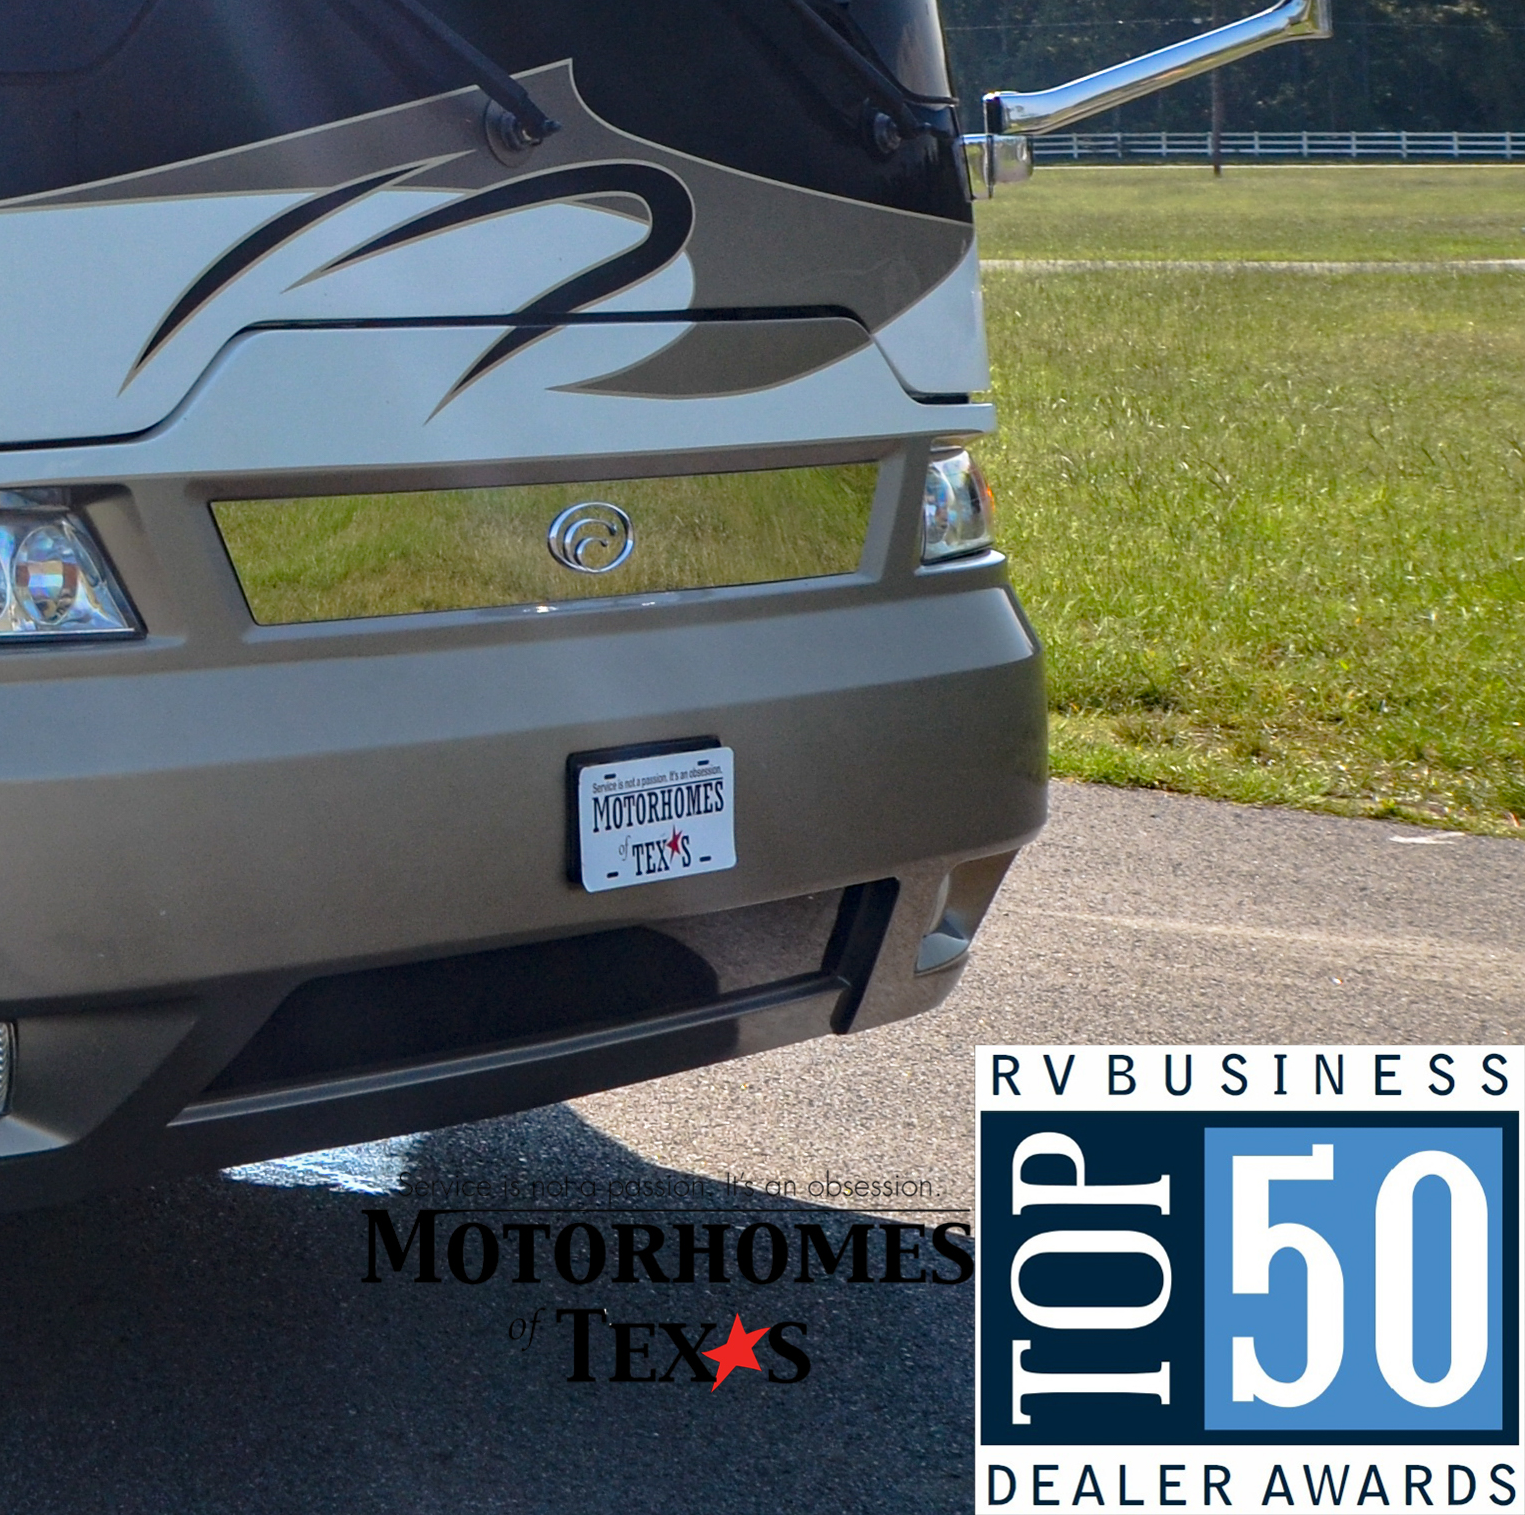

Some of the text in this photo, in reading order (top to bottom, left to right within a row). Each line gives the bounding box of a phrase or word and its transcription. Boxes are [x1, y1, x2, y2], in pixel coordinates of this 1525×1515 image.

[592, 764, 723, 794] Service is not a passion. It's an obsession.
[592, 780, 725, 834] MOTORHOMES
[618, 825, 692, 877] of TEXS
